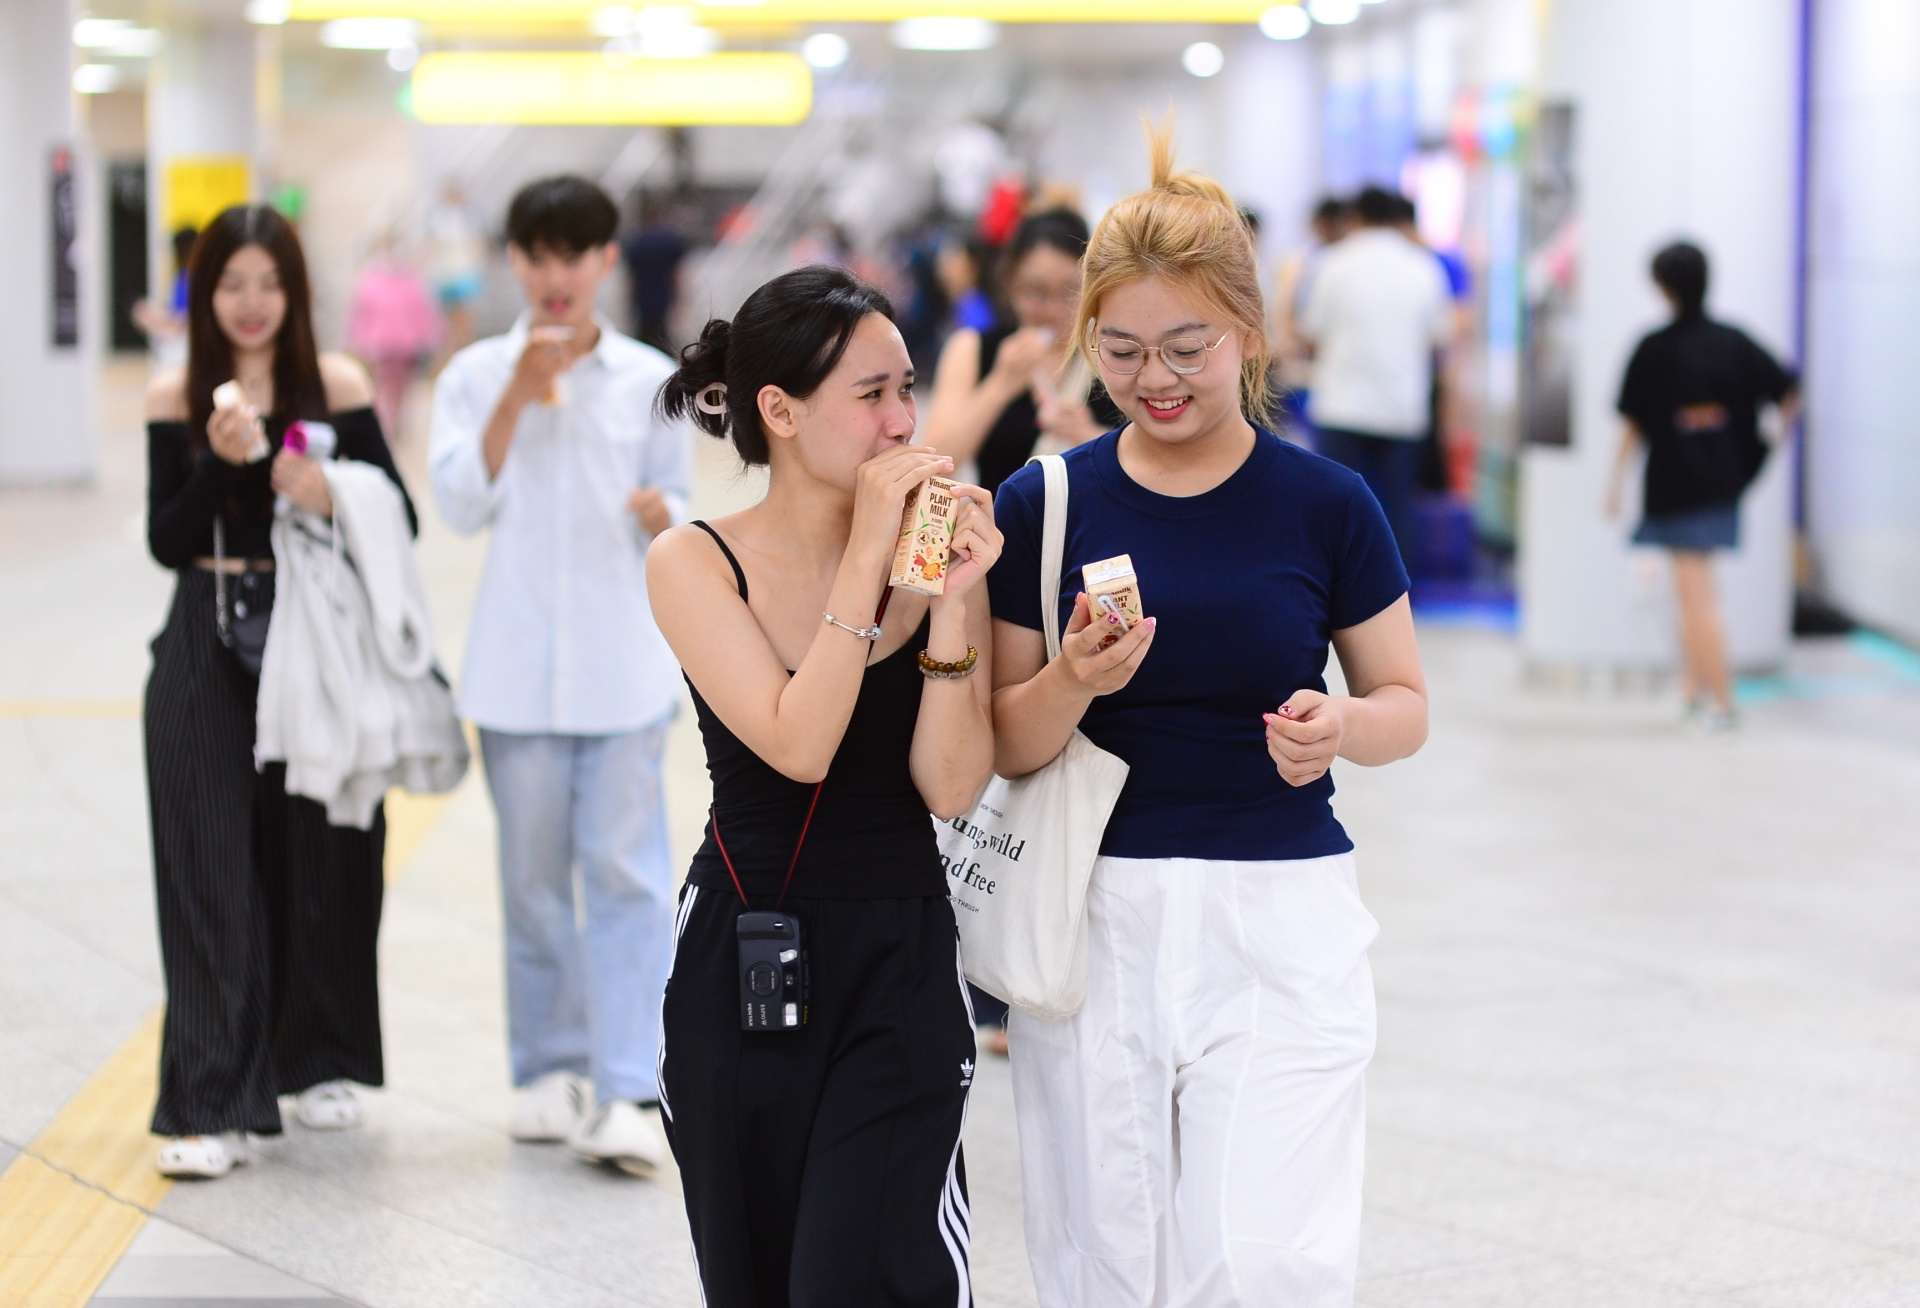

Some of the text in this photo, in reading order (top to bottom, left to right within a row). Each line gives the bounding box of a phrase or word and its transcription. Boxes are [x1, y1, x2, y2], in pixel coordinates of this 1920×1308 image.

[930, 492, 952, 507] PLANT
[930, 504, 948, 518] MILK
[989, 833, 1026, 861] wild
[940, 853, 996, 895] nd free
[958, 898, 980, 914] THROUGH
